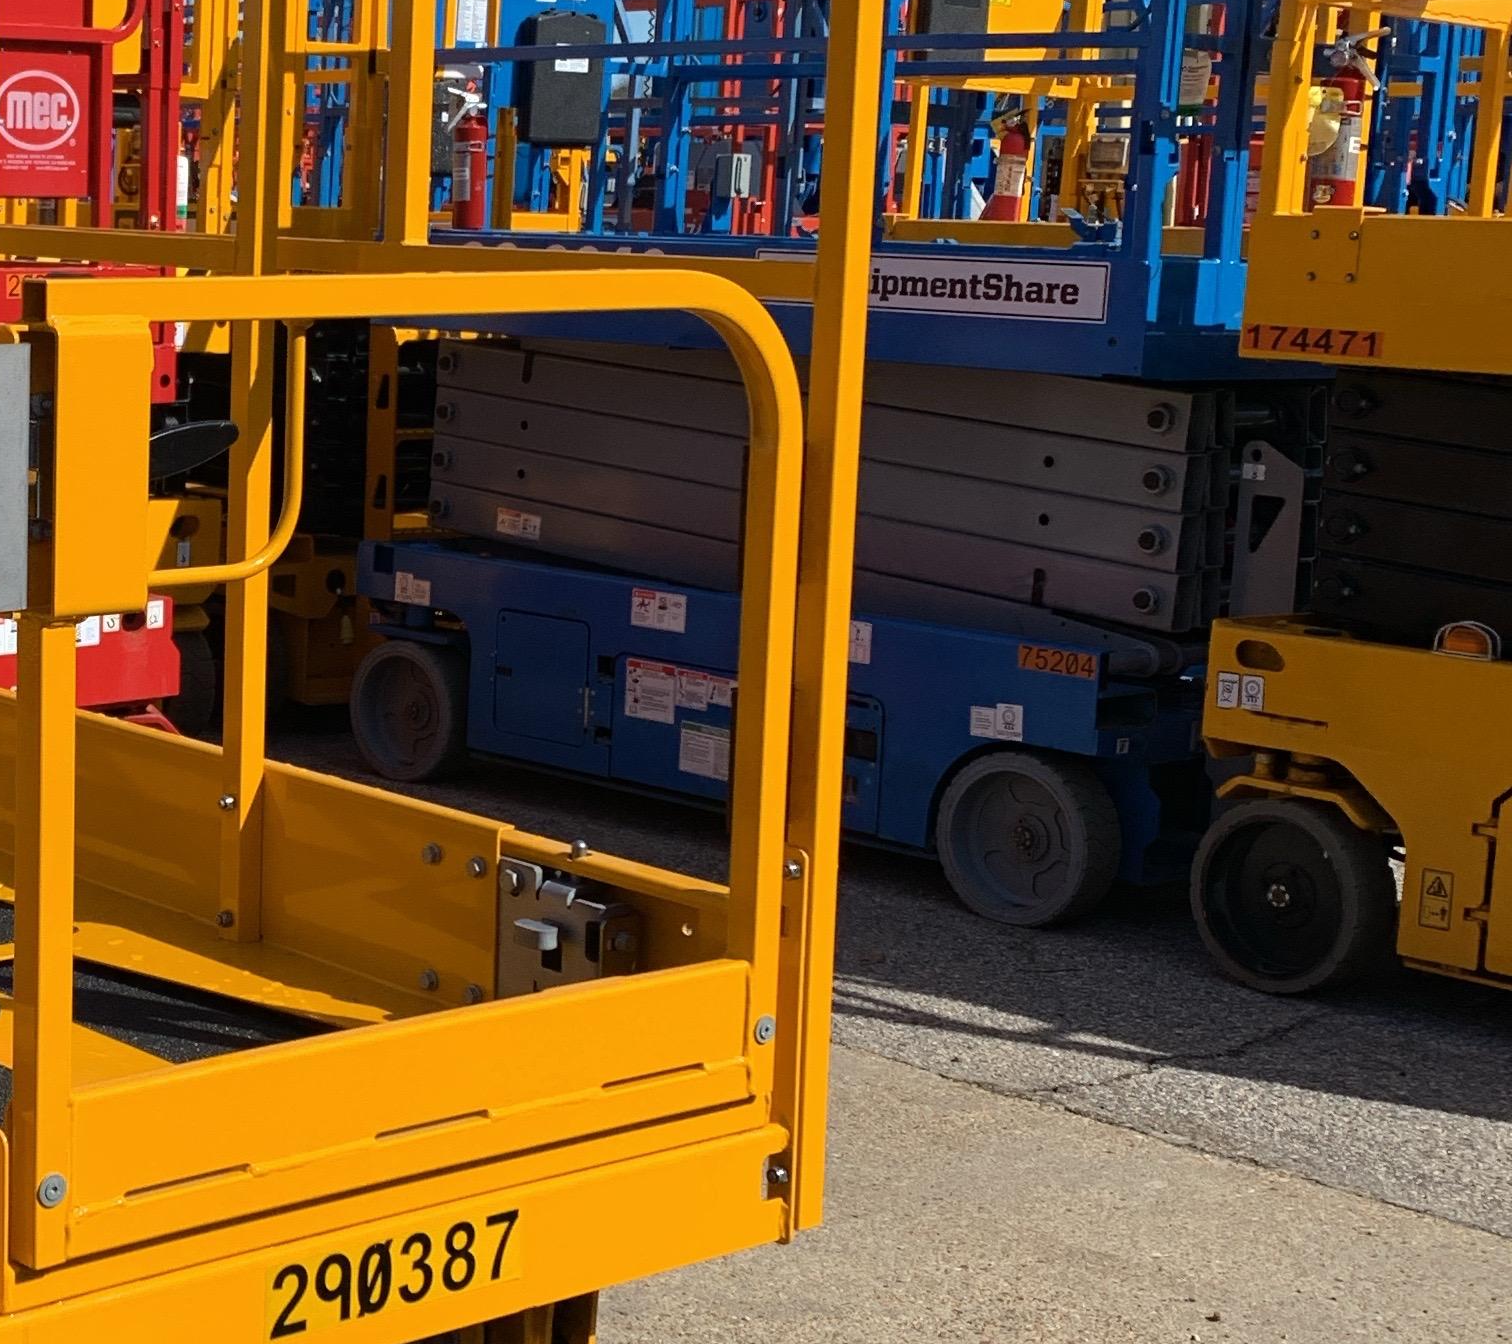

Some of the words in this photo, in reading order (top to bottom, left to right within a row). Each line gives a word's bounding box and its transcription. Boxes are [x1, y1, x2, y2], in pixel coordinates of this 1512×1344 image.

[870, 268, 1080, 305] ipmentShare
[1245, 322, 1380, 357] 174471
[1020, 646, 1095, 678] 75204
[269, 1210, 520, 1339] 290387
